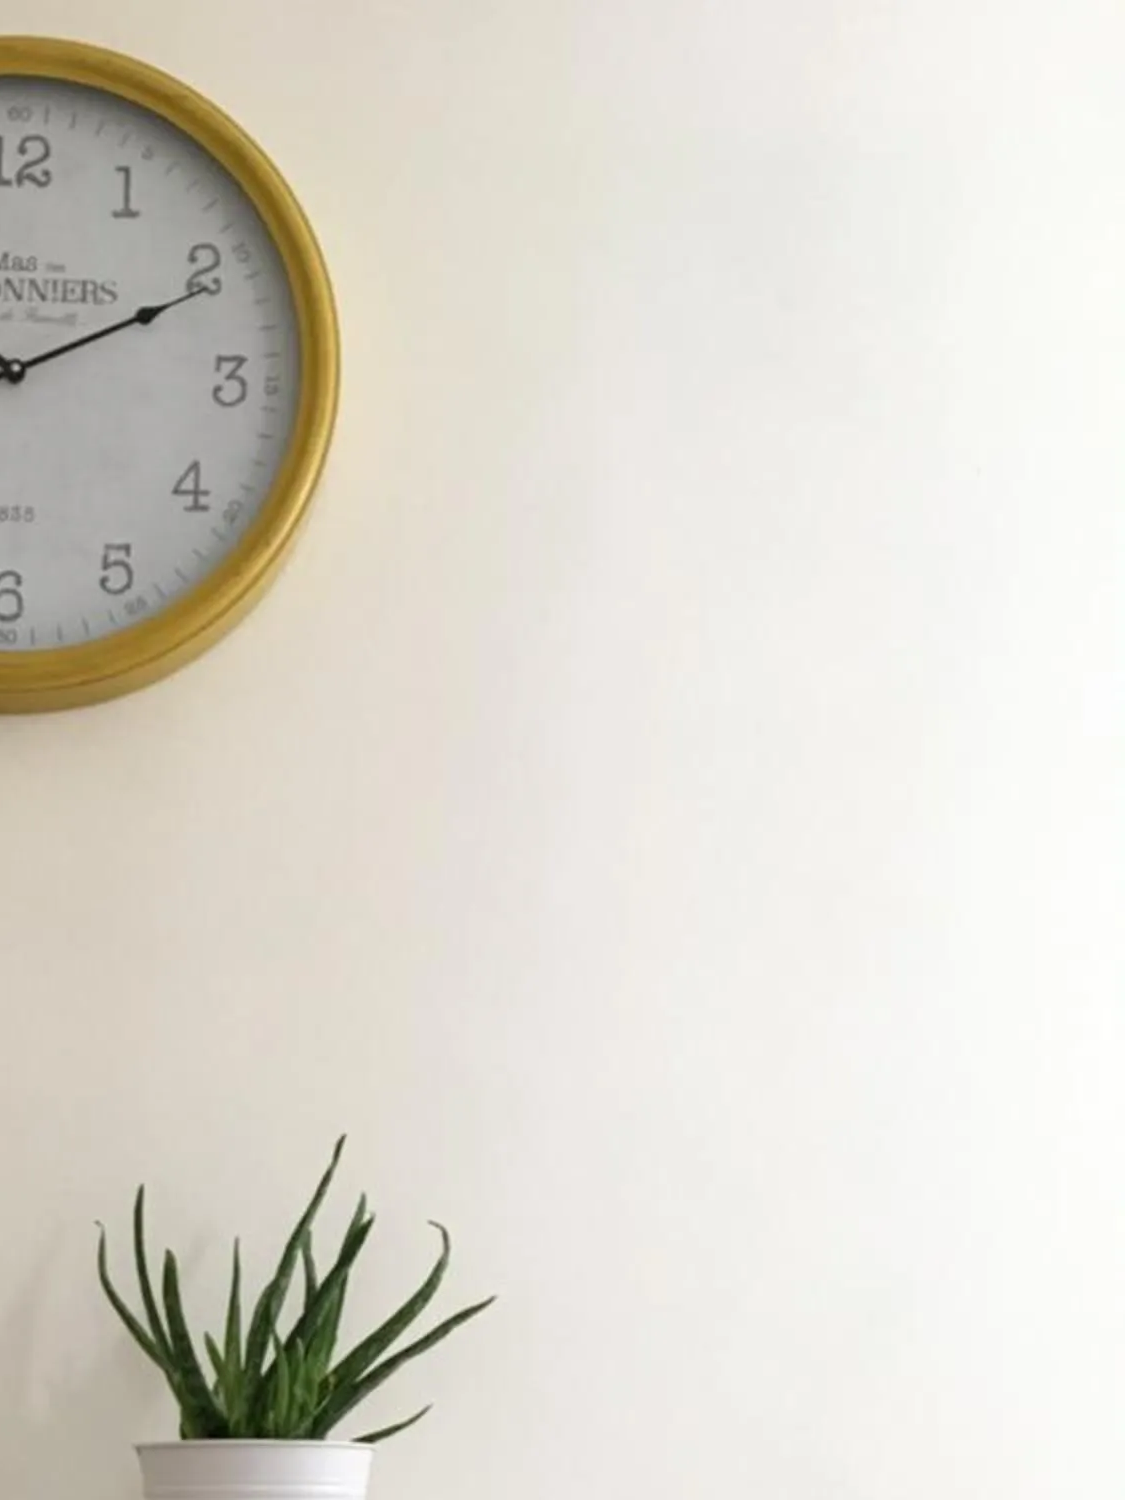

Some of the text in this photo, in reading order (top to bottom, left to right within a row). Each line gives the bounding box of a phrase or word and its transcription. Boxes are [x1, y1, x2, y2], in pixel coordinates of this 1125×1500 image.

[111, 165, 141, 219] 1
[185, 242, 222, 296] 2
[212, 355, 248, 408] 3
[171, 459, 211, 512] 4
[99, 542, 134, 595] 5
